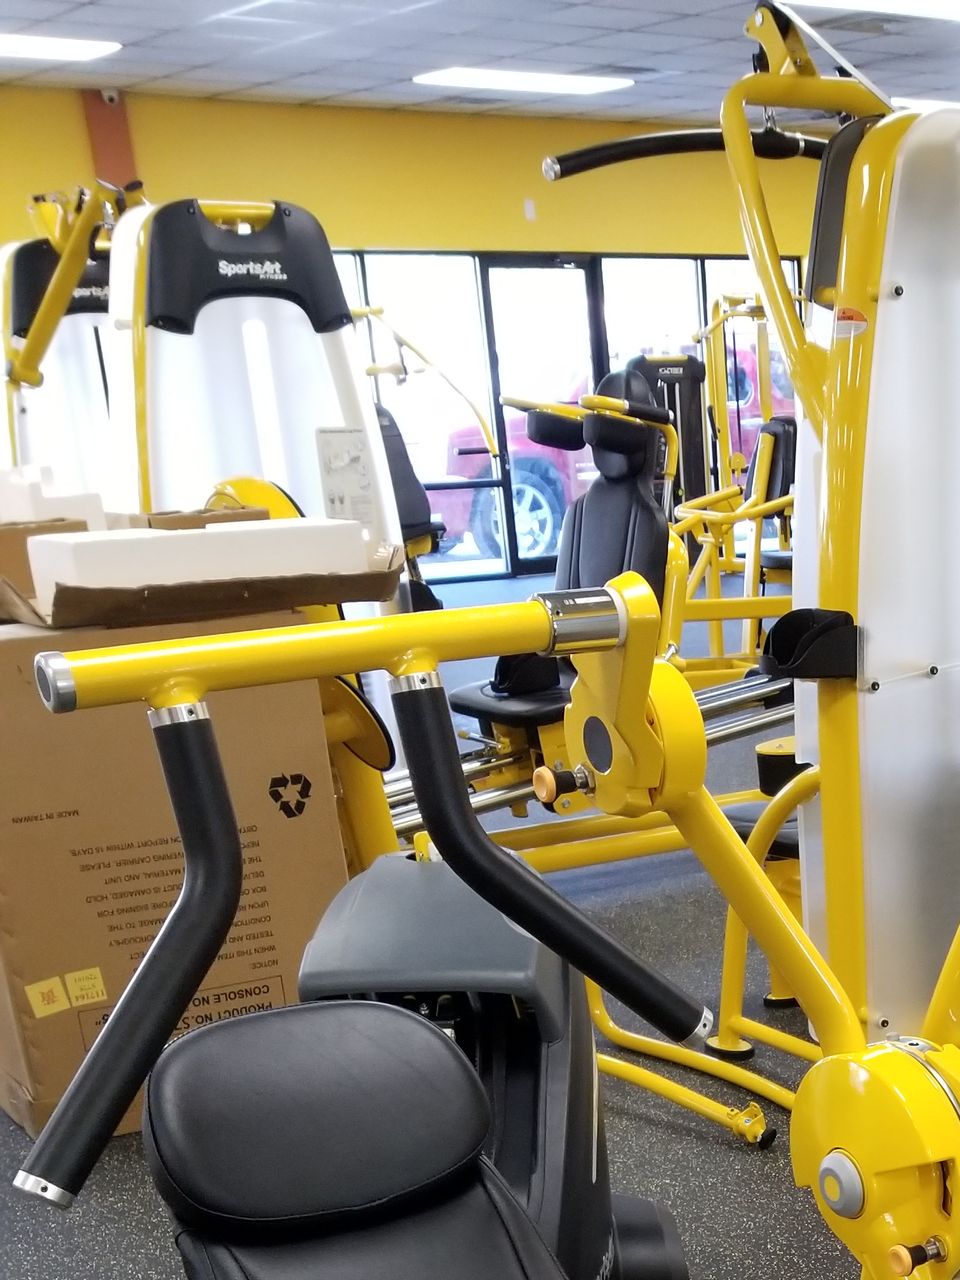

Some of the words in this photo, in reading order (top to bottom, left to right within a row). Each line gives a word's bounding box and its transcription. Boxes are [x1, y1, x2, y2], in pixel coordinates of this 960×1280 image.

[218, 259, 282, 276] SportsArt
[11, 814, 44, 824] TAIWAN
[45, 812, 55, 820] IN
[56, 809, 80, 819] MADE
[106, 841, 135, 852] WITHIN
[137, 837, 169, 849] REPORT
[153, 851, 185, 862] IVERING
[79, 862, 111, 873] PLEASE
[104, 875, 123, 886] UNIT
[123, 874, 141, 882] AND
[243, 870, 265, 881] DELIV
[163, 883, 184, 893] DUCT
[85, 894, 108, 904] HOLD
[248, 900, 270, 909] UPON
[96, 908, 114, 919] FOR
[116, 903, 150, 915] SIGNING
[124, 922, 136, 930] TO
[138, 917, 167, 928] AMAGE
[107, 924, 124, 933] THE
[245, 930, 275, 941] TESTED
[108, 935, 154, 948] OROUGHLY
[236, 949, 253, 957] THIS
[253, 944, 277, 954] WHEN
[212, 984, 271, 1004] CONSOLE
[218, 1002, 273, 1020] PRODUCT
